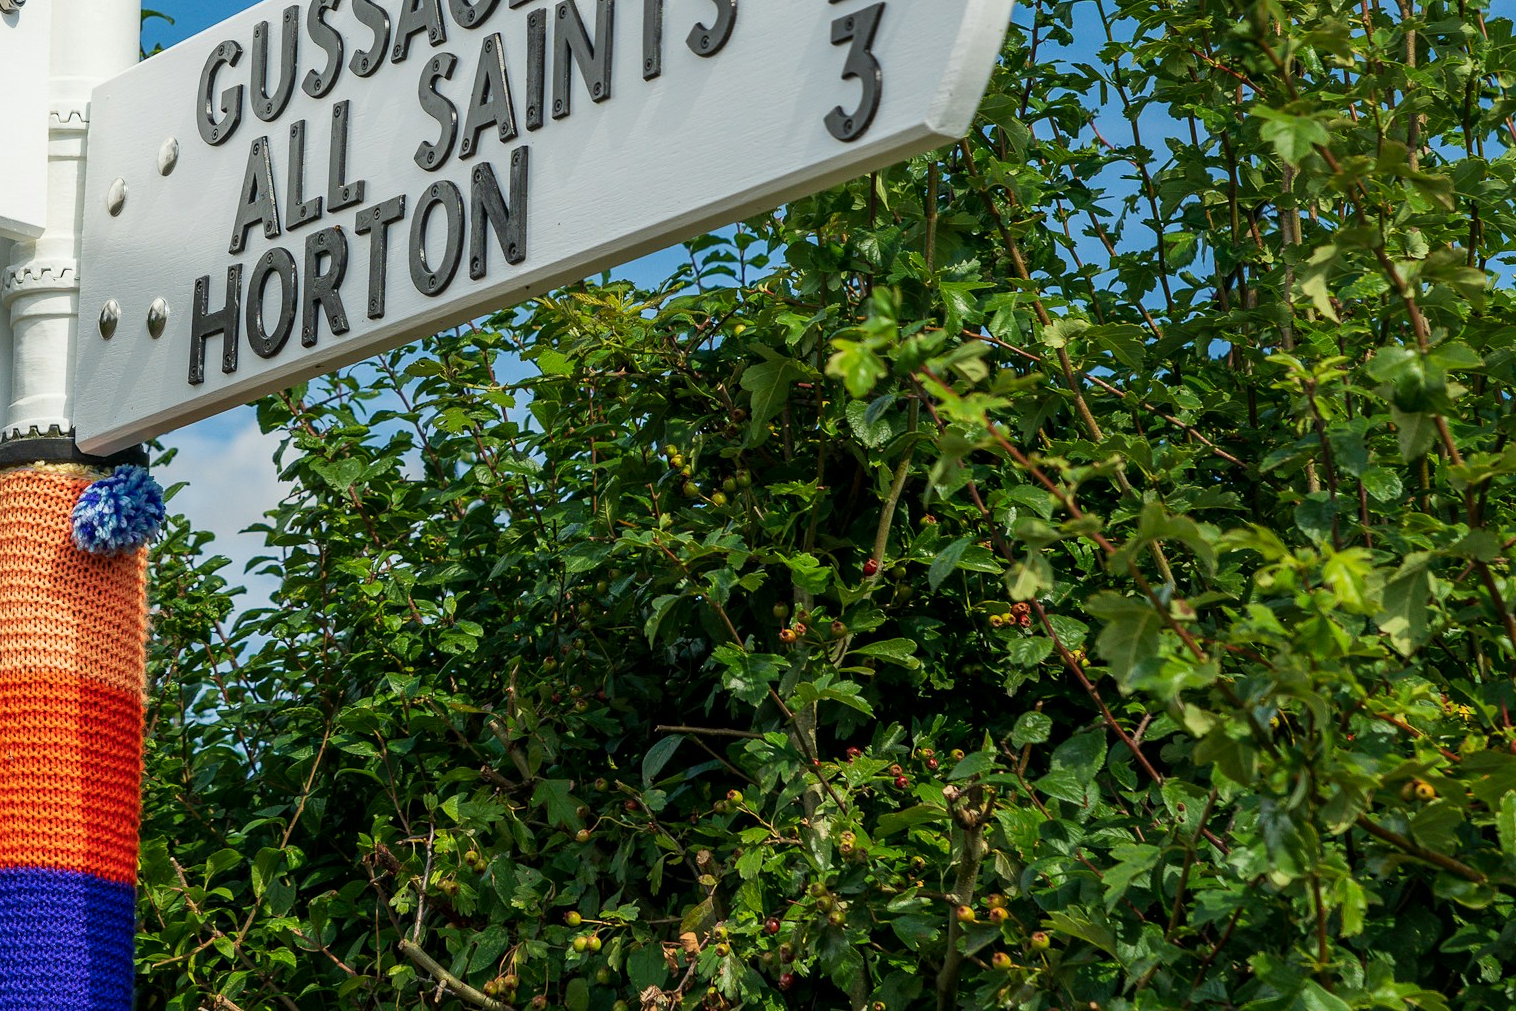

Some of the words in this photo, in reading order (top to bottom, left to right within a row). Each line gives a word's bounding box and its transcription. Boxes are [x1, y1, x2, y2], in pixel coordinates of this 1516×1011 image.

[188, 145, 530, 385] HORTON
[824, 2, 887, 143] 3
[229, 99, 366, 254] ALL
